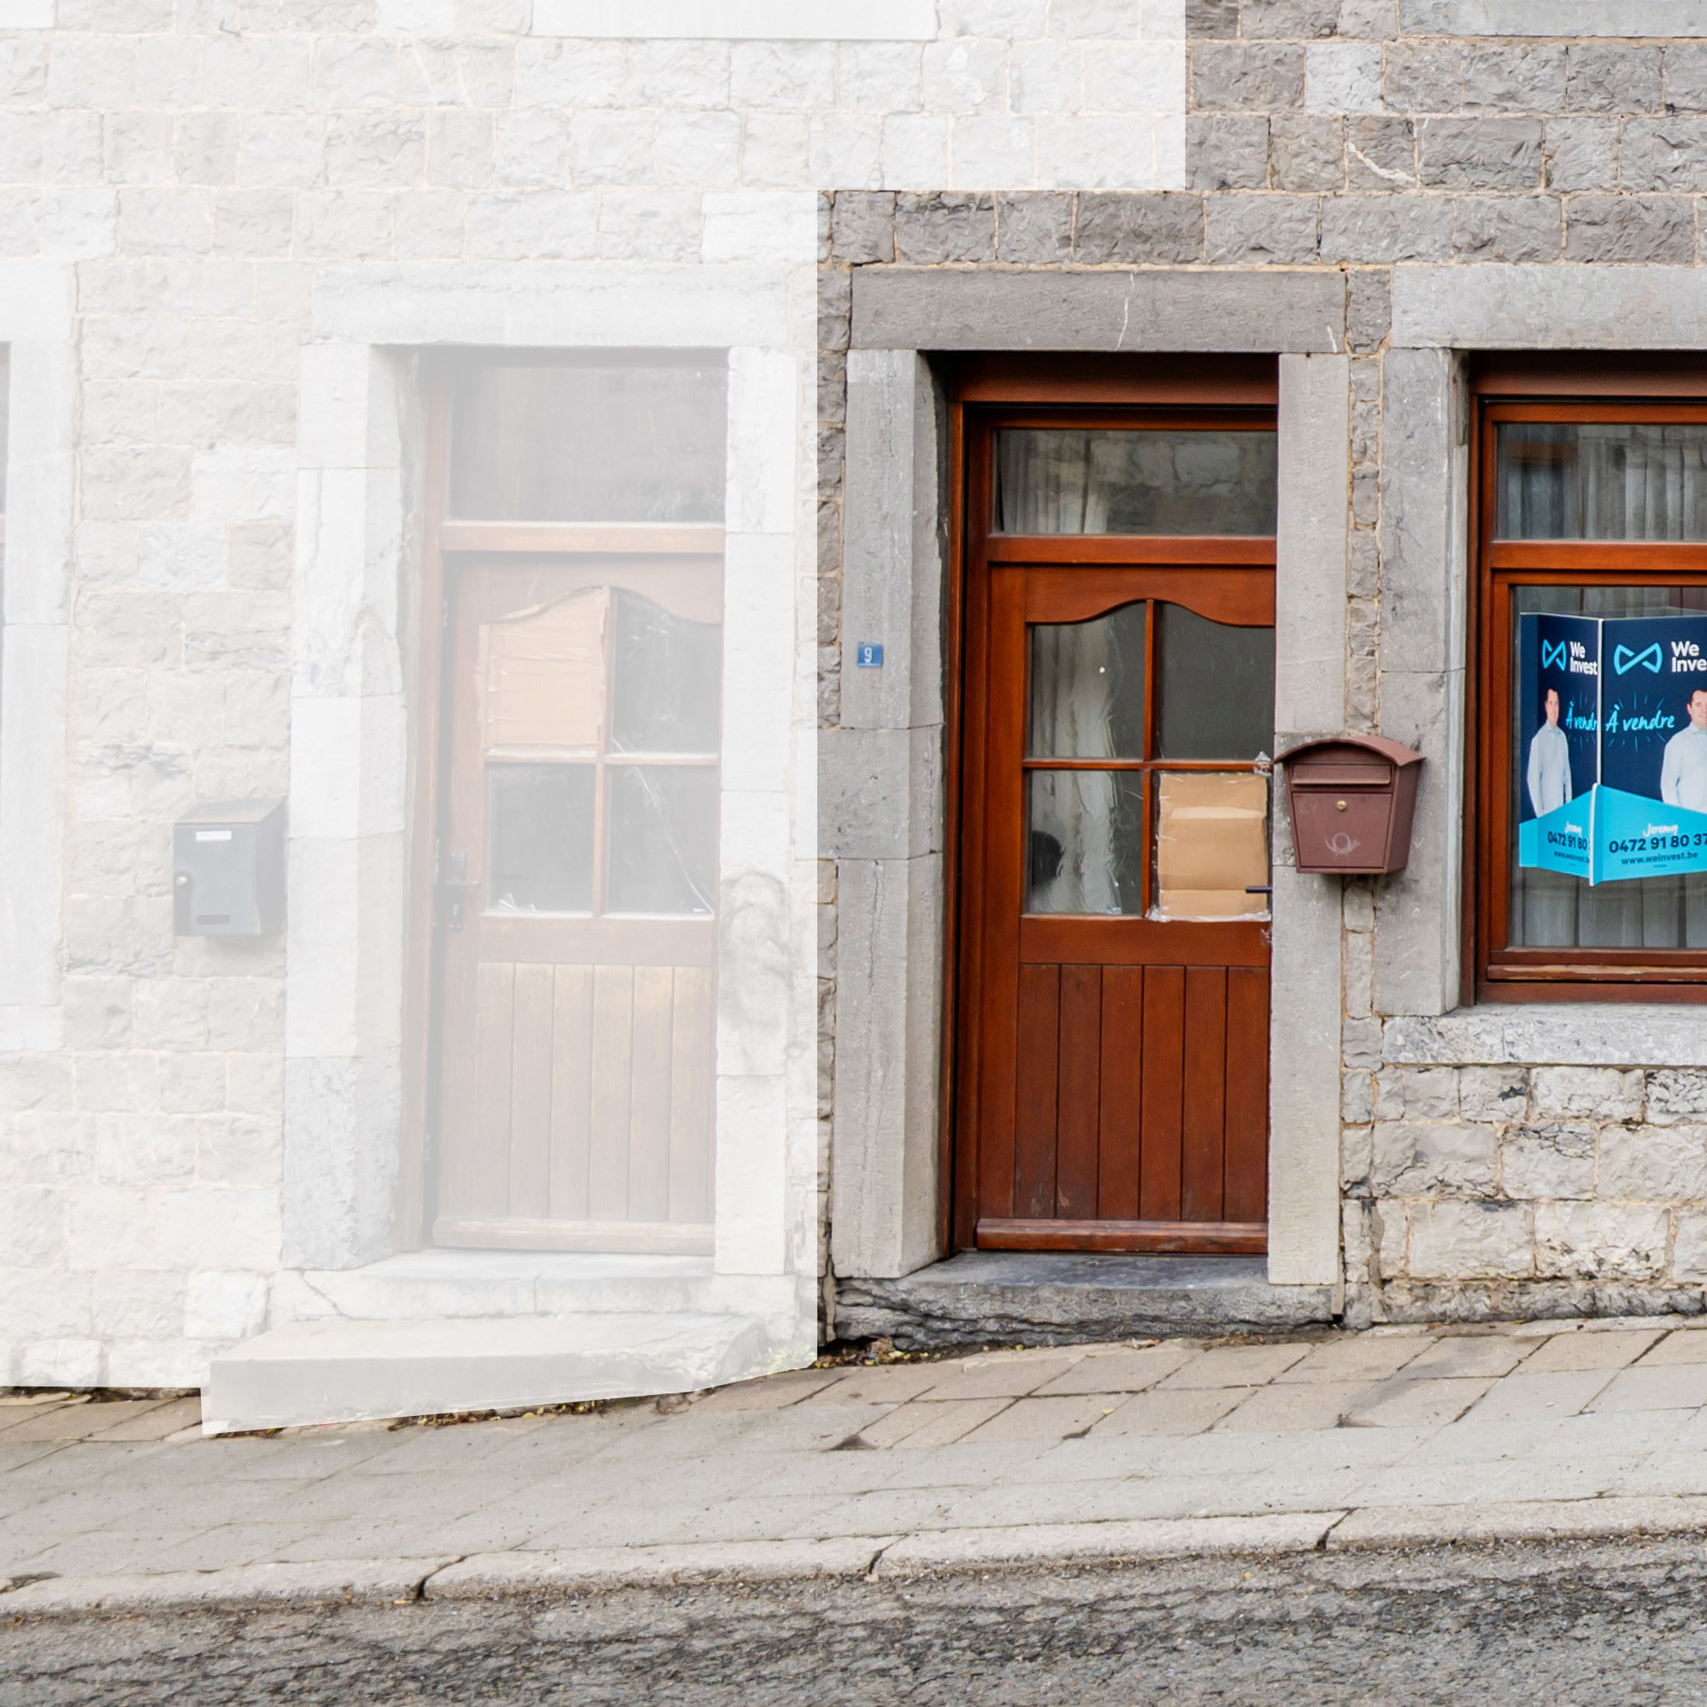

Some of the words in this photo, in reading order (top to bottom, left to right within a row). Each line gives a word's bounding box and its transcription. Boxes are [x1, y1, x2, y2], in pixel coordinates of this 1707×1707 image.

[863, 646, 873, 663] 9
[1570, 640, 1586, 658] We
[1671, 641, 1700, 657] We
[1570, 657, 1598, 676] Invest
[1605, 704, 1620, 733] À
[1622, 709, 1676, 731] vendre
[1548, 830, 1566, 847] 0472
[1609, 838, 1647, 853] 0472
[1650, 836, 1667, 849] 91
[1671, 835, 1690, 848] 80
[1621, 850, 1699, 866] www.weinvest.be
